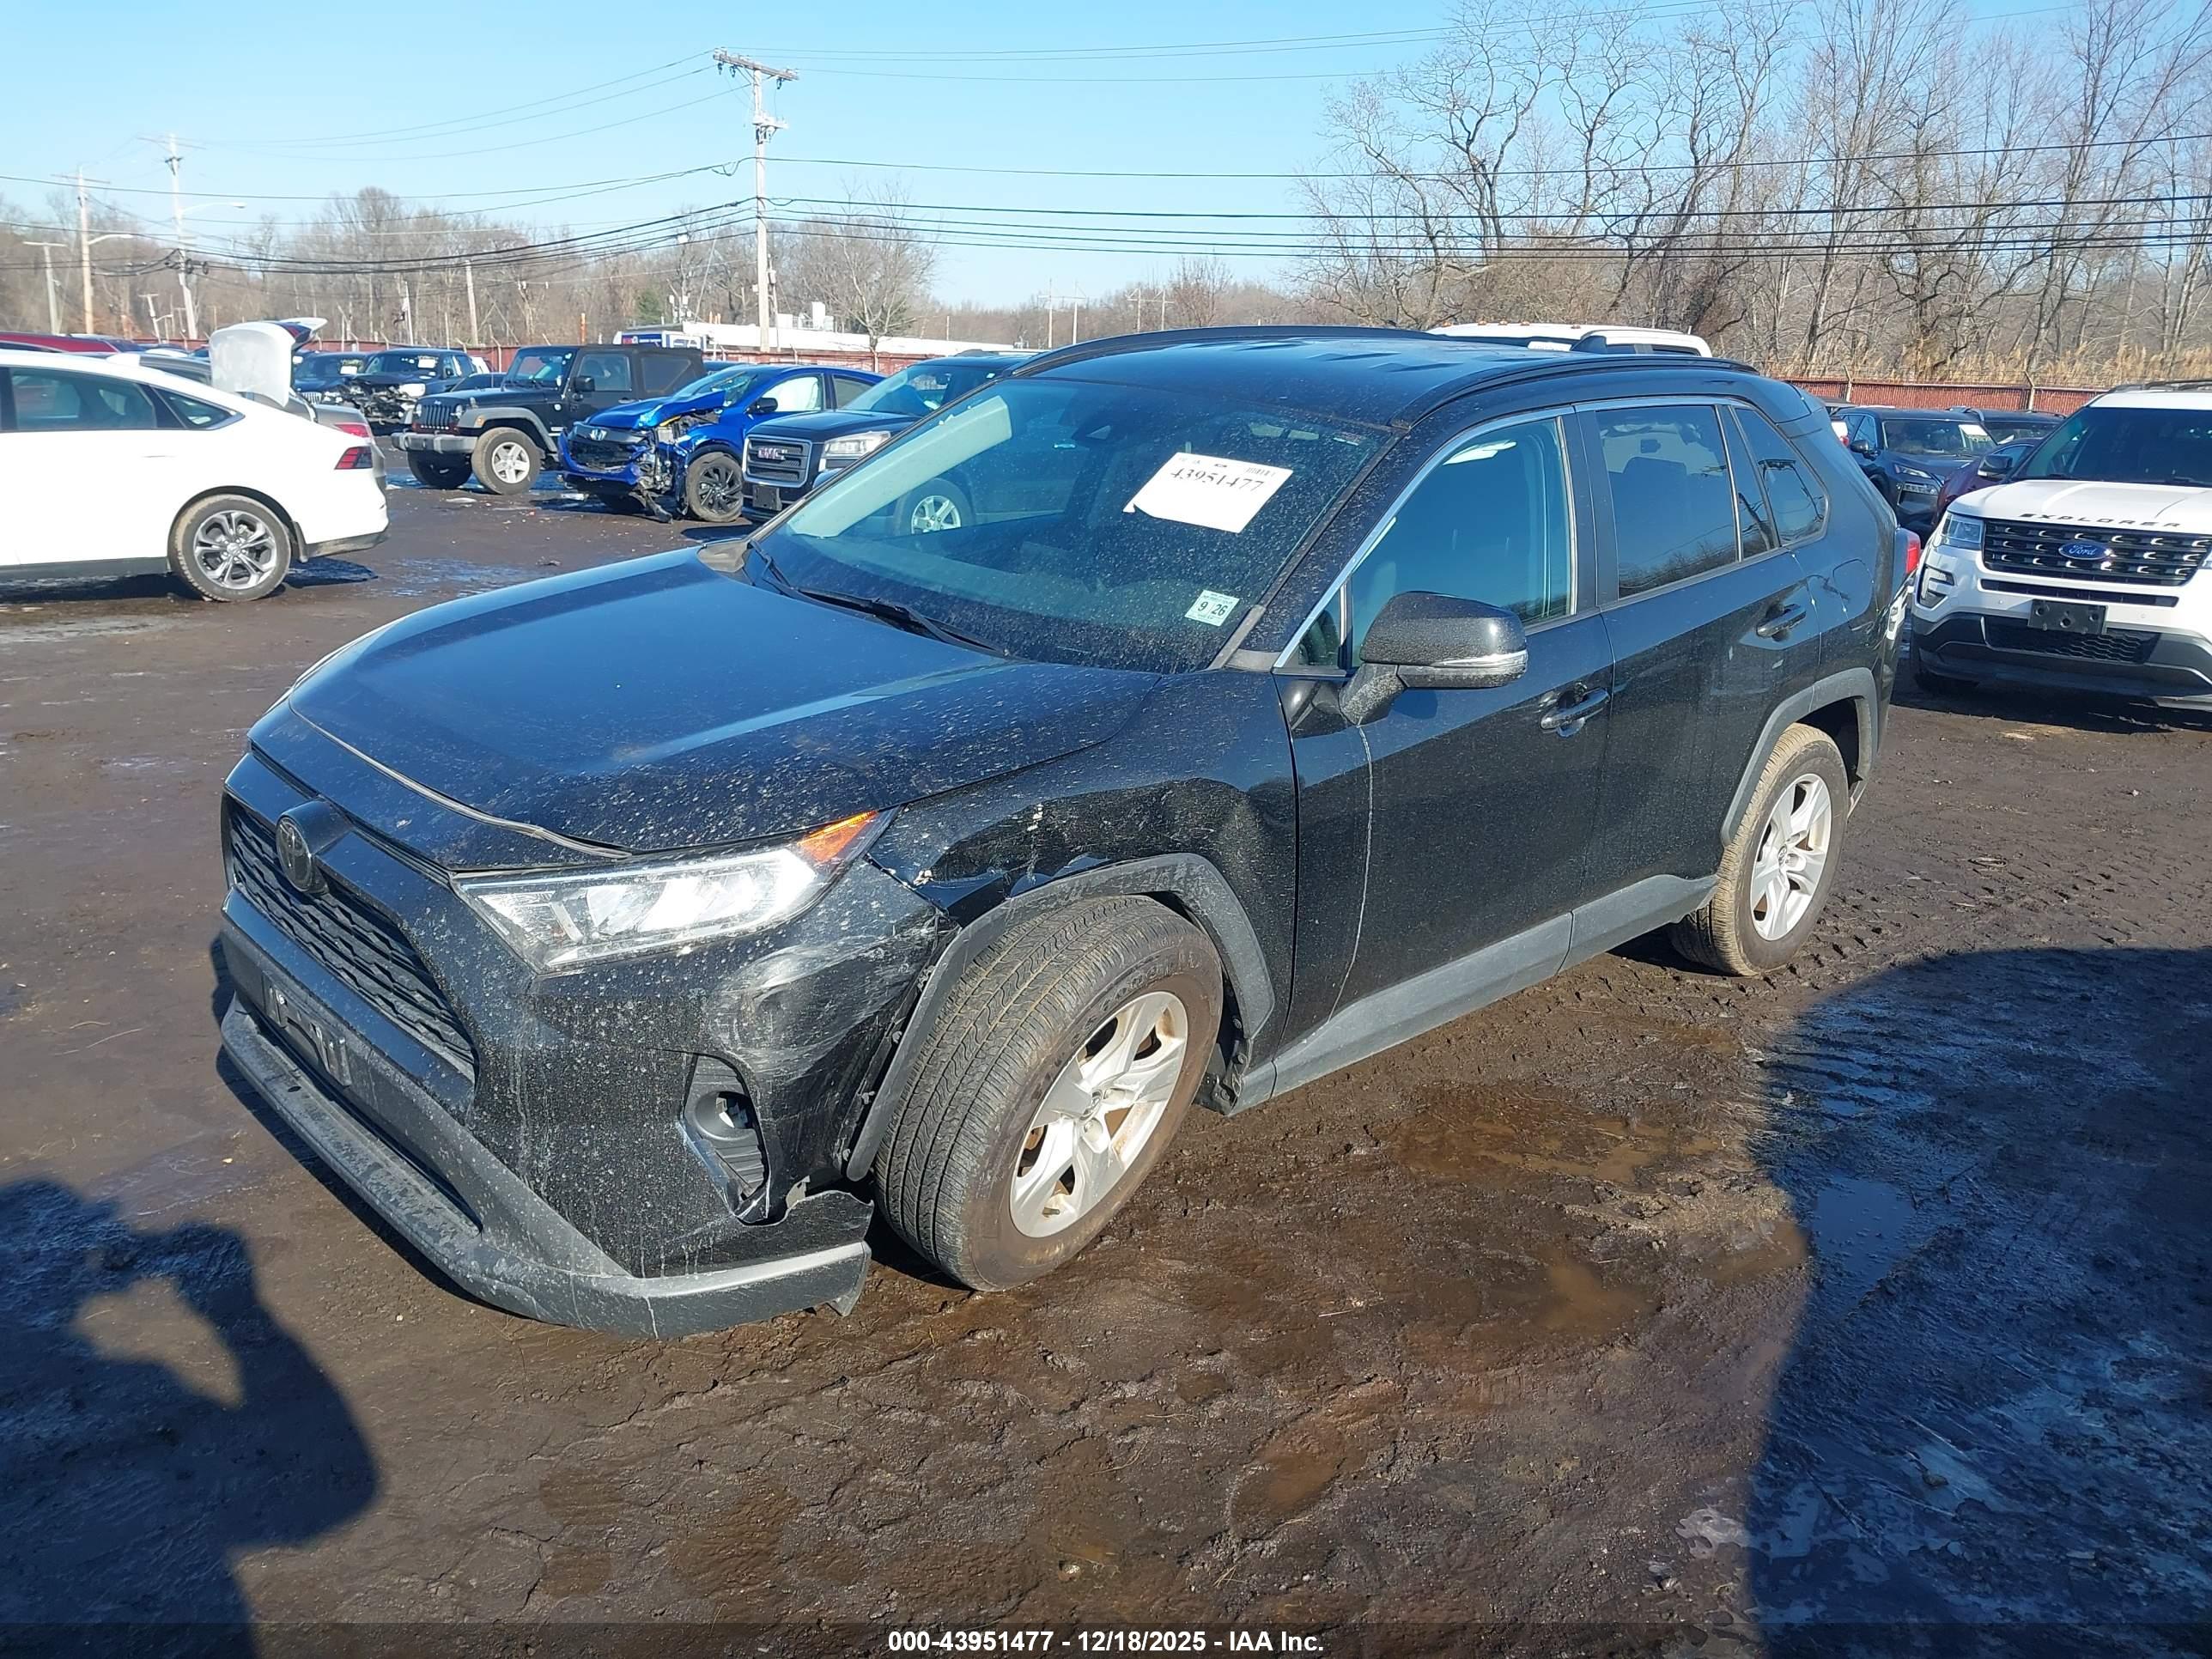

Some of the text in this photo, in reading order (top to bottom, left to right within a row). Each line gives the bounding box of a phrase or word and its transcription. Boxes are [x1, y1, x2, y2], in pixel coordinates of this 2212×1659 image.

[1170, 467, 1265, 492] 43951477
[2019, 513, 2181, 527] EXPLORER
[2068, 544, 2097, 556] Ford
[1197, 601, 1229, 617] 9 26
